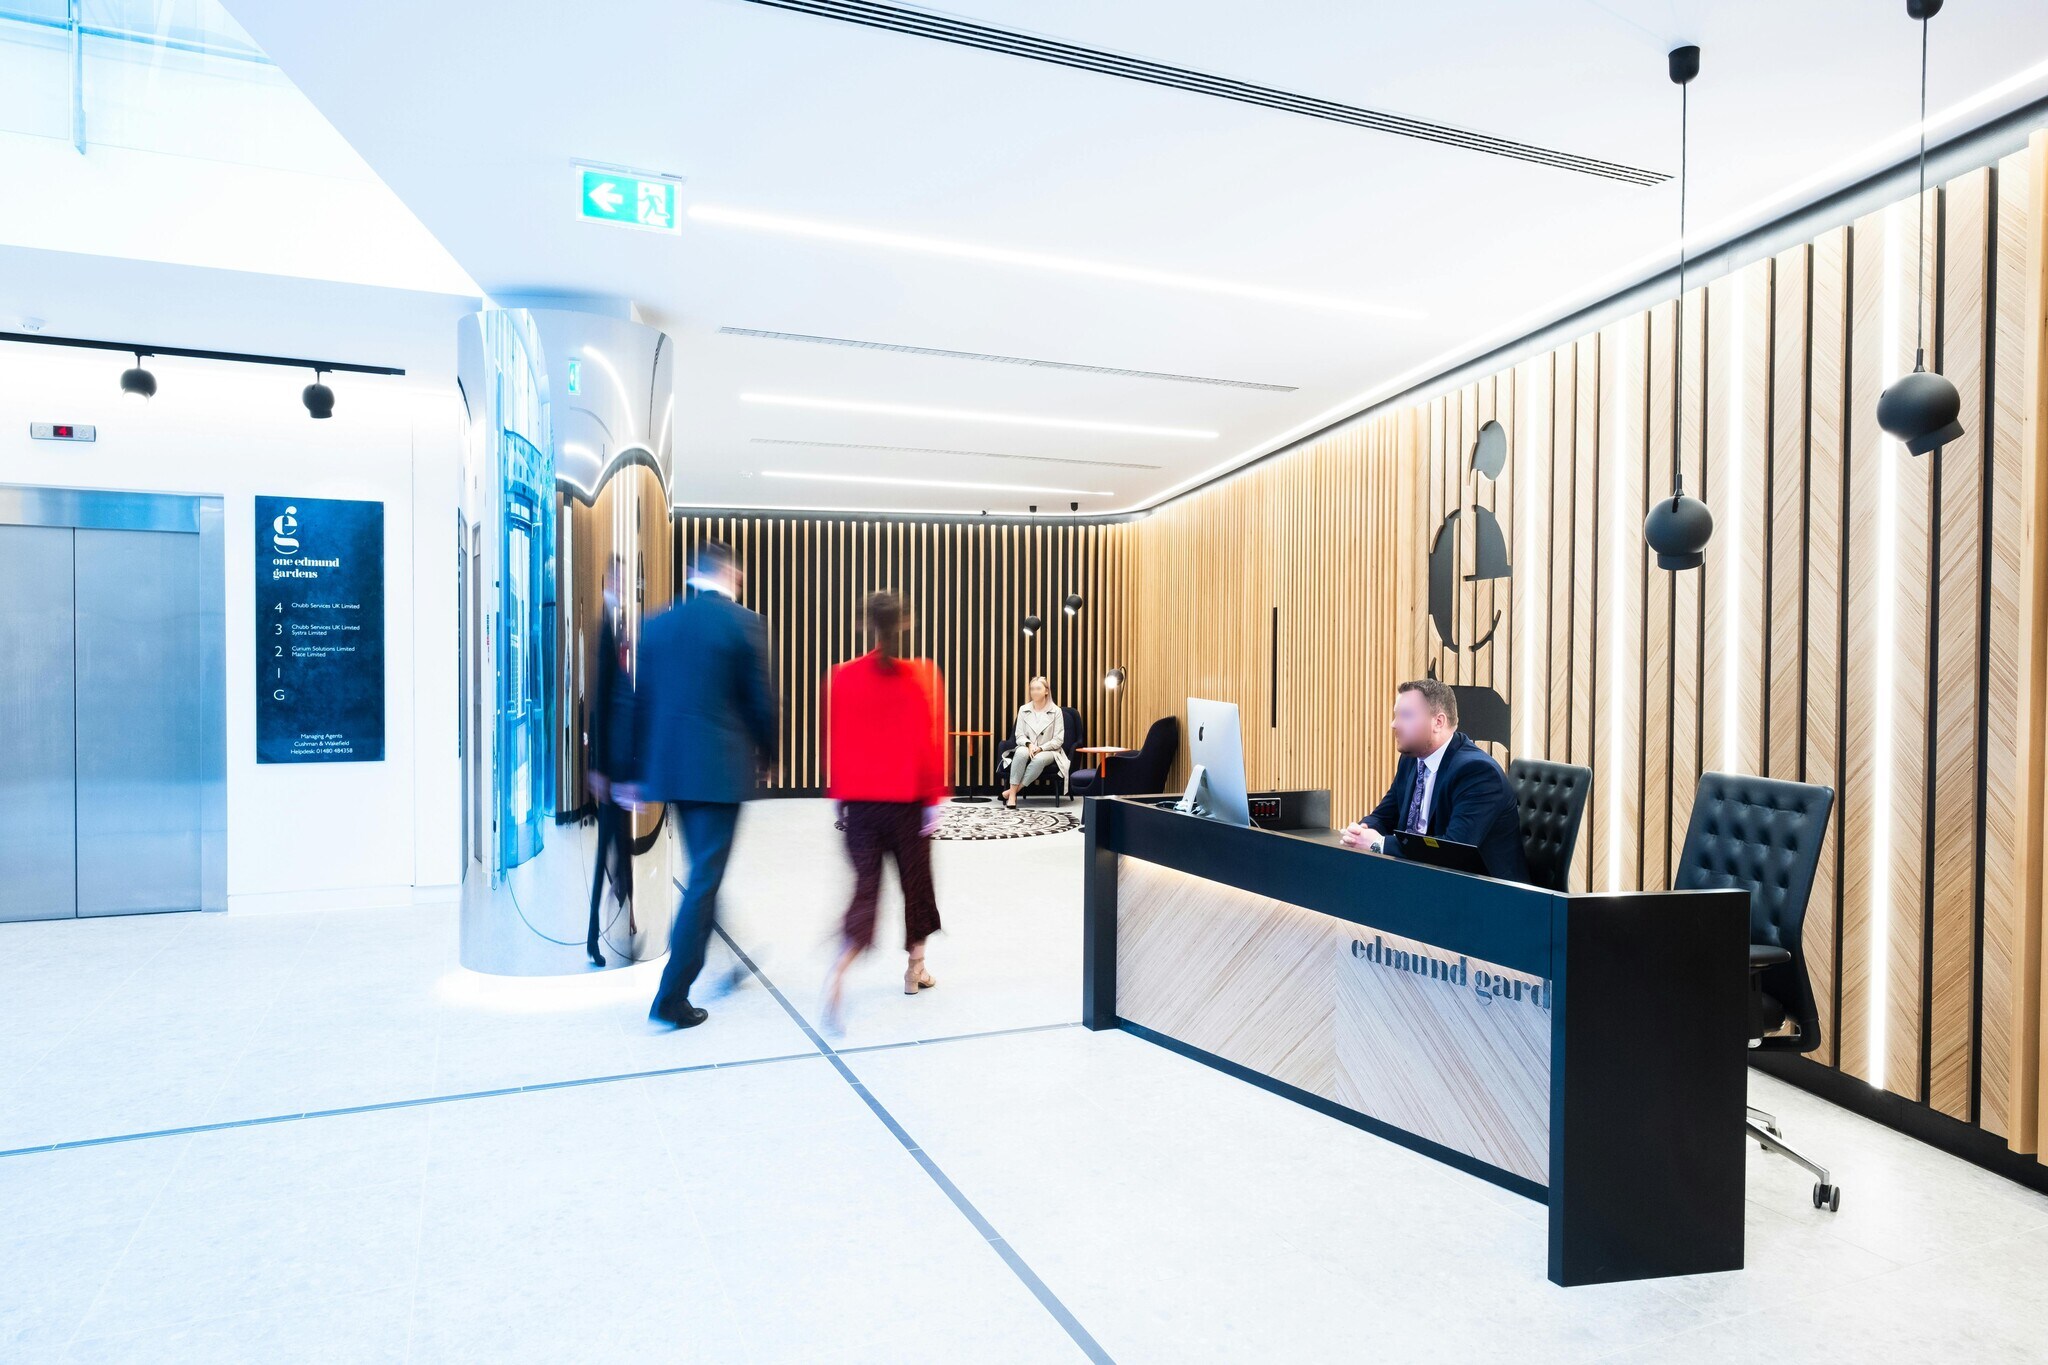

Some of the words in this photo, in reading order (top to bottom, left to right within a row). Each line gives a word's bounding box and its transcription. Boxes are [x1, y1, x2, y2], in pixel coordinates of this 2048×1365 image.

[272, 558, 293, 566] one
[294, 557, 340, 568] edmund
[272, 568, 318, 581] gardens
[274, 602, 283, 613] 4
[274, 623, 283, 635] 3
[274, 645, 283, 657] 2
[273, 689, 285, 701] G
[1351, 935, 1467, 987] edmund
